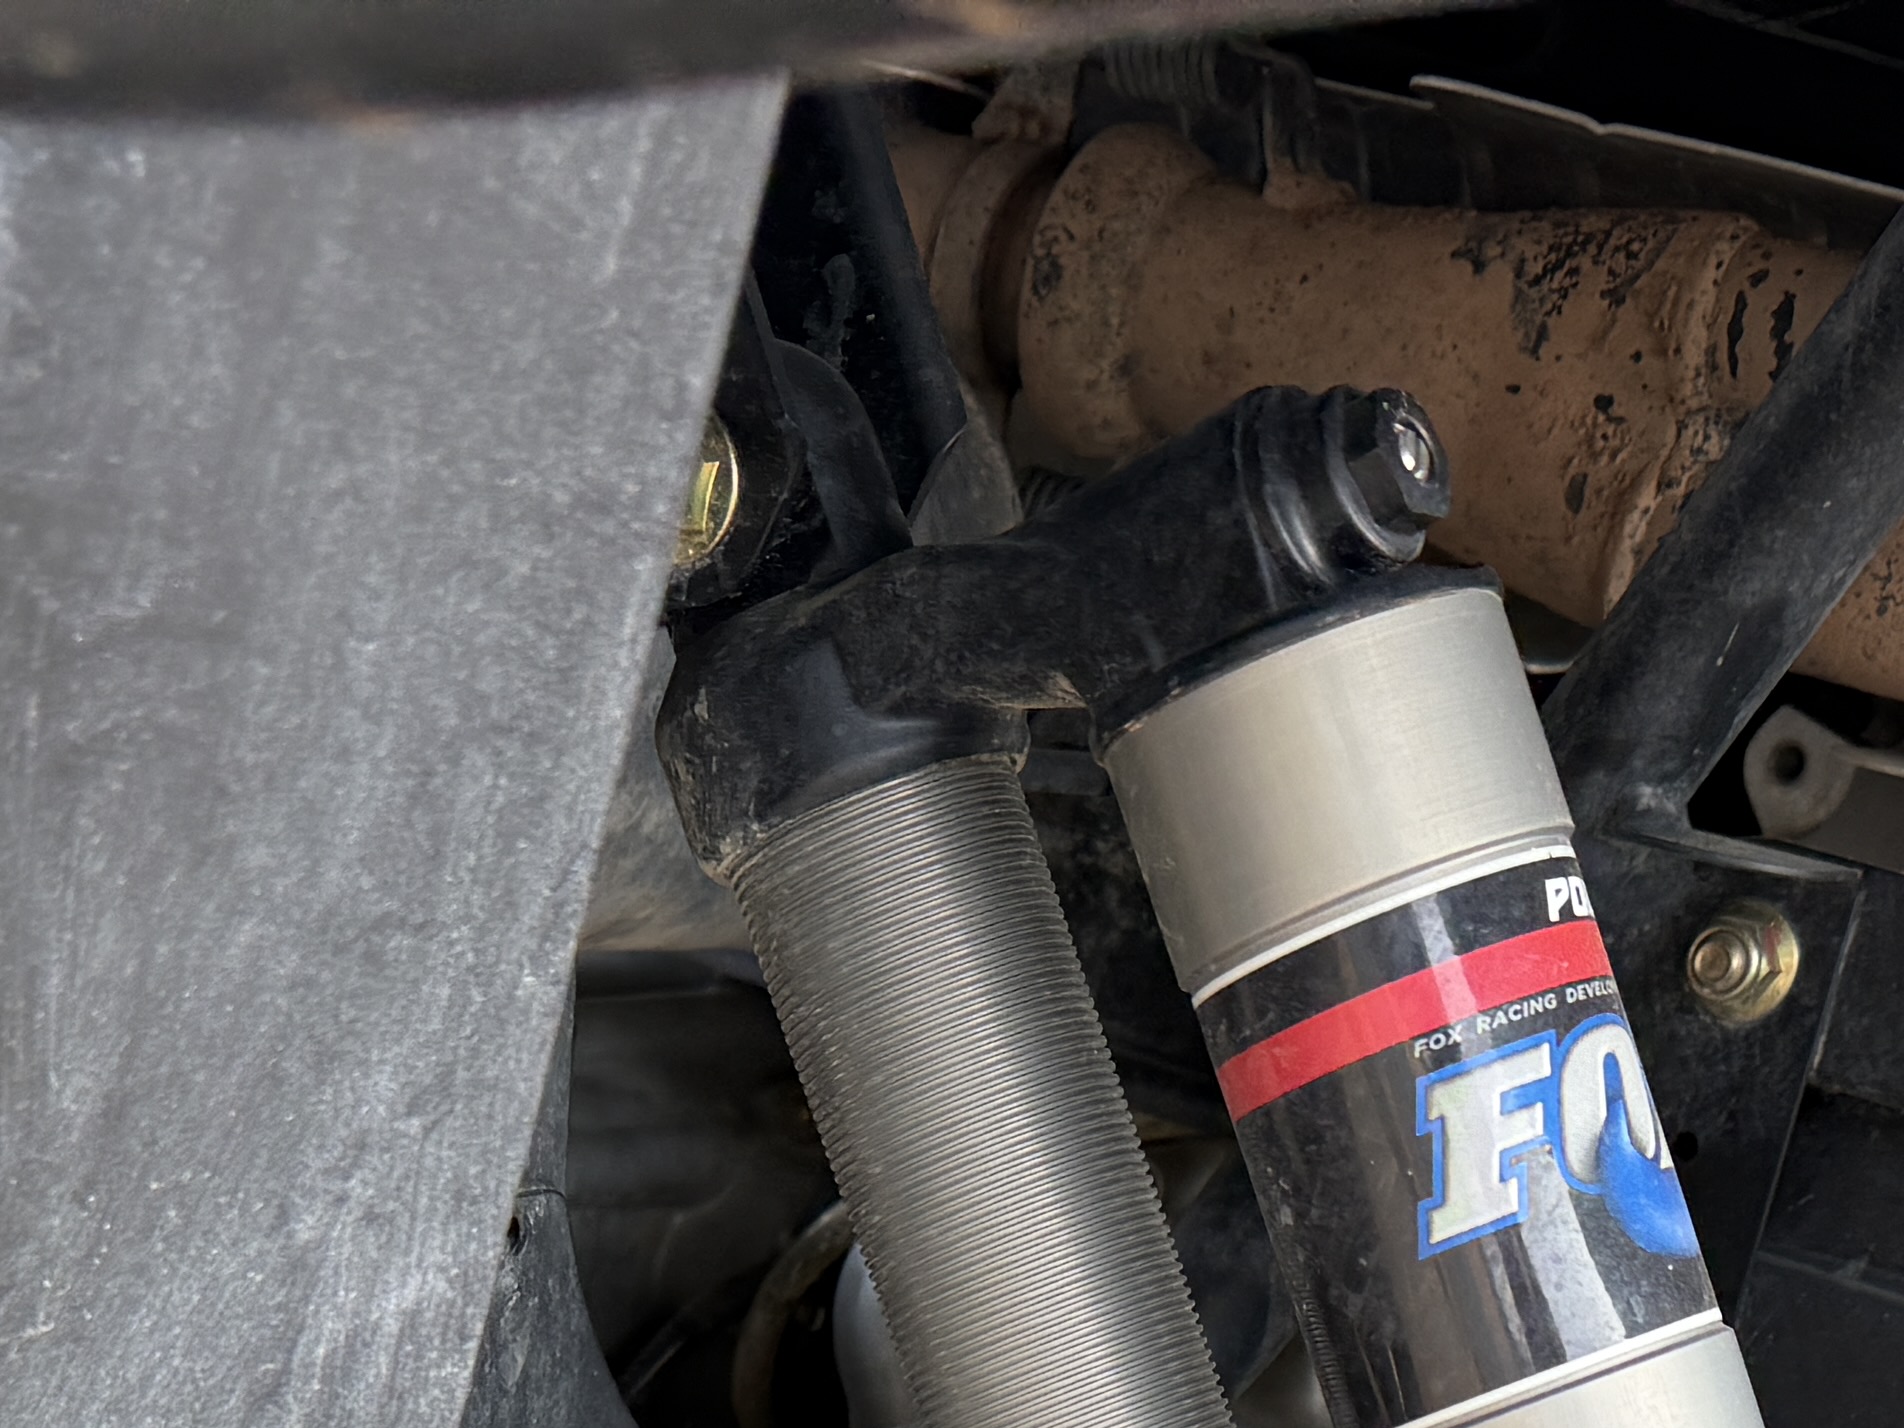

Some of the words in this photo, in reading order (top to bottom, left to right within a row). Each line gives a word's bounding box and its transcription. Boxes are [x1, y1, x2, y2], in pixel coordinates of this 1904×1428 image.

[1544, 875, 1595, 922] PO
[1414, 1024, 1463, 1058] FOX
[1476, 992, 1558, 1035] RACING
[1416, 1012, 1674, 1260] FO
